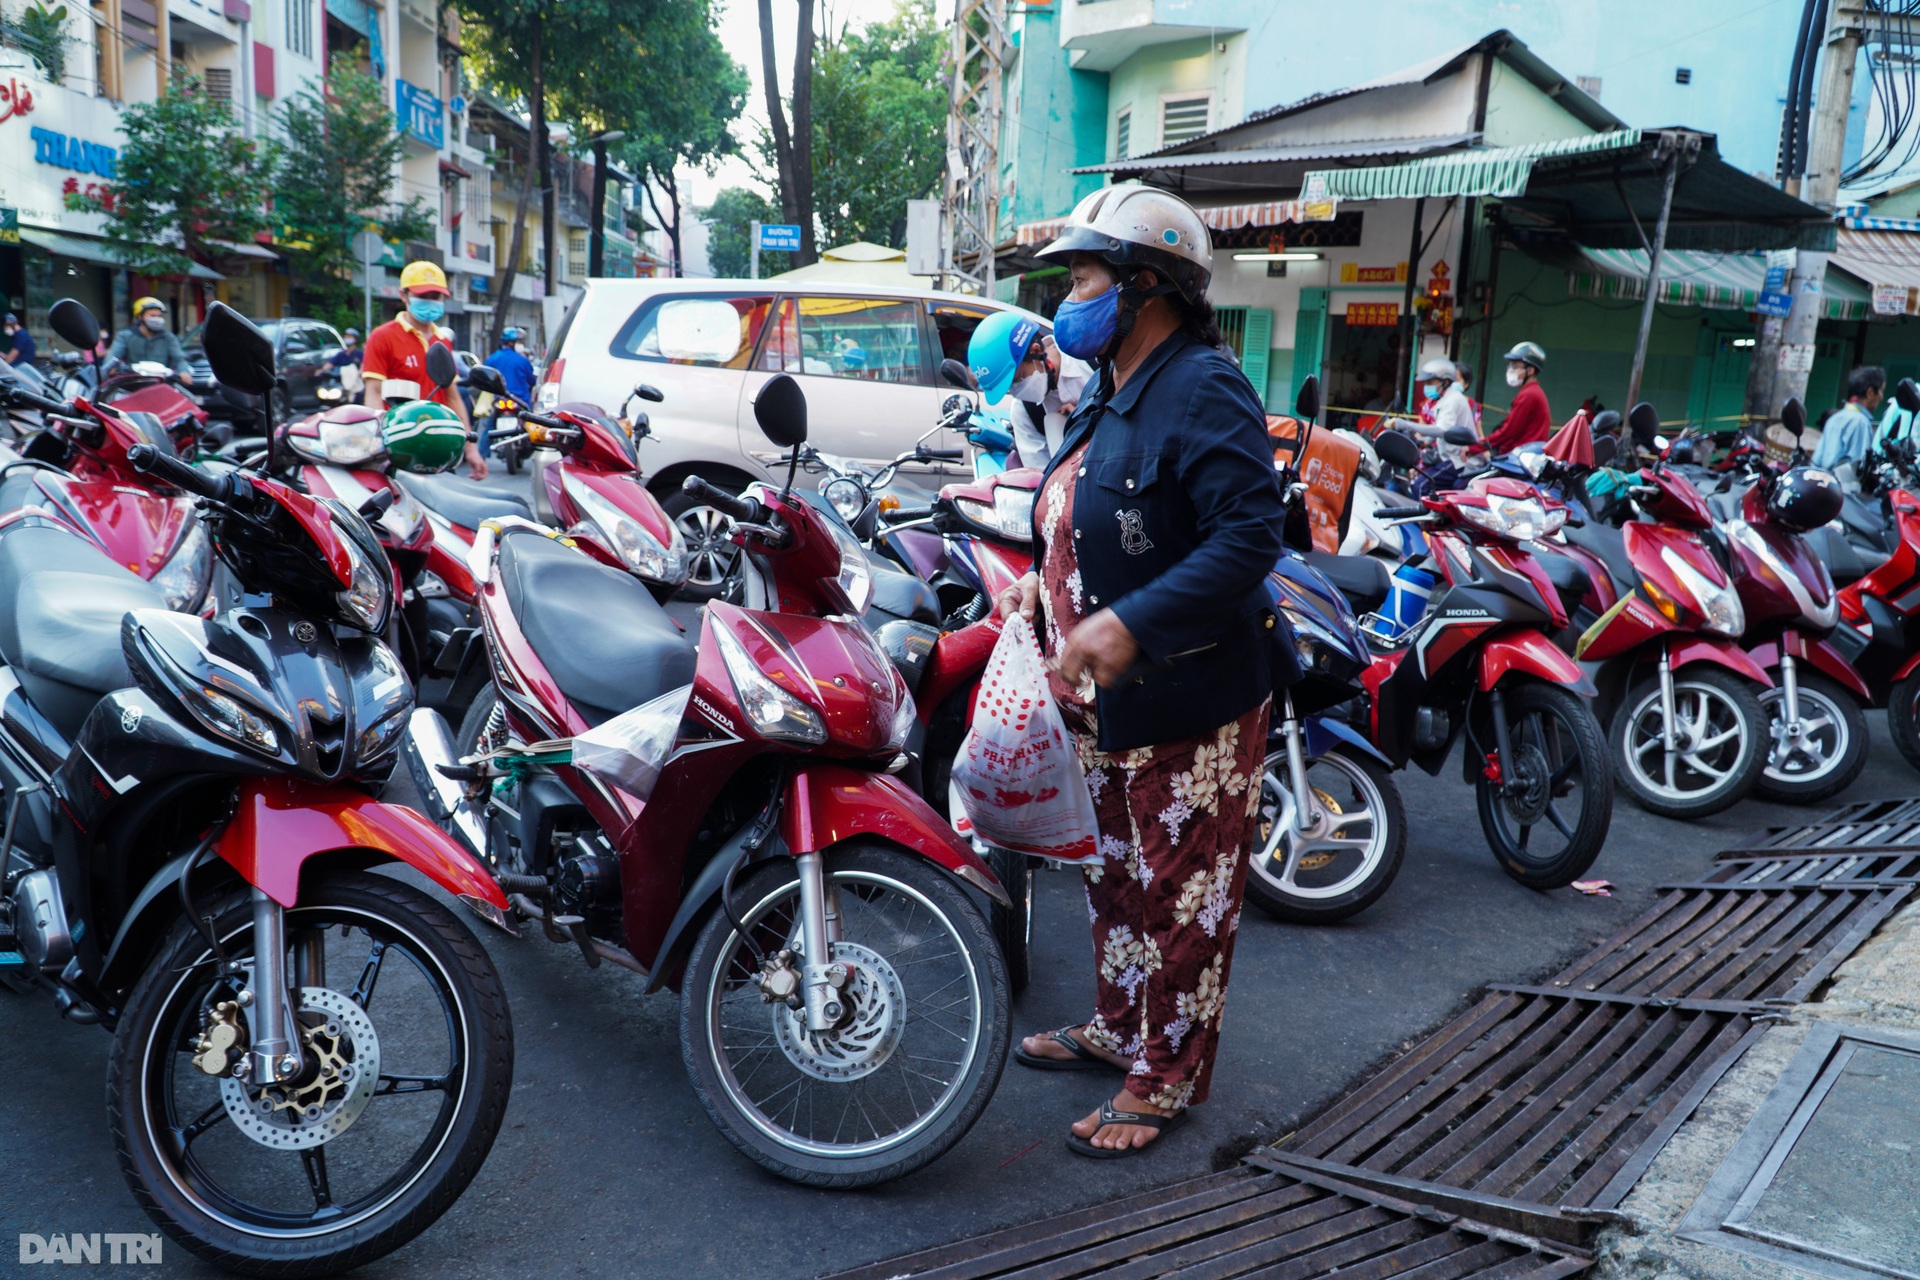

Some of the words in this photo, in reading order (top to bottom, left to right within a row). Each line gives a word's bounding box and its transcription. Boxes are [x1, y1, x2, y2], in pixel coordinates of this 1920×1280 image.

[405, 354, 418, 368] 41
[1318, 473, 1343, 494] Food
[1446, 608, 1489, 617] HONDA
[693, 695, 735, 731] HONDA
